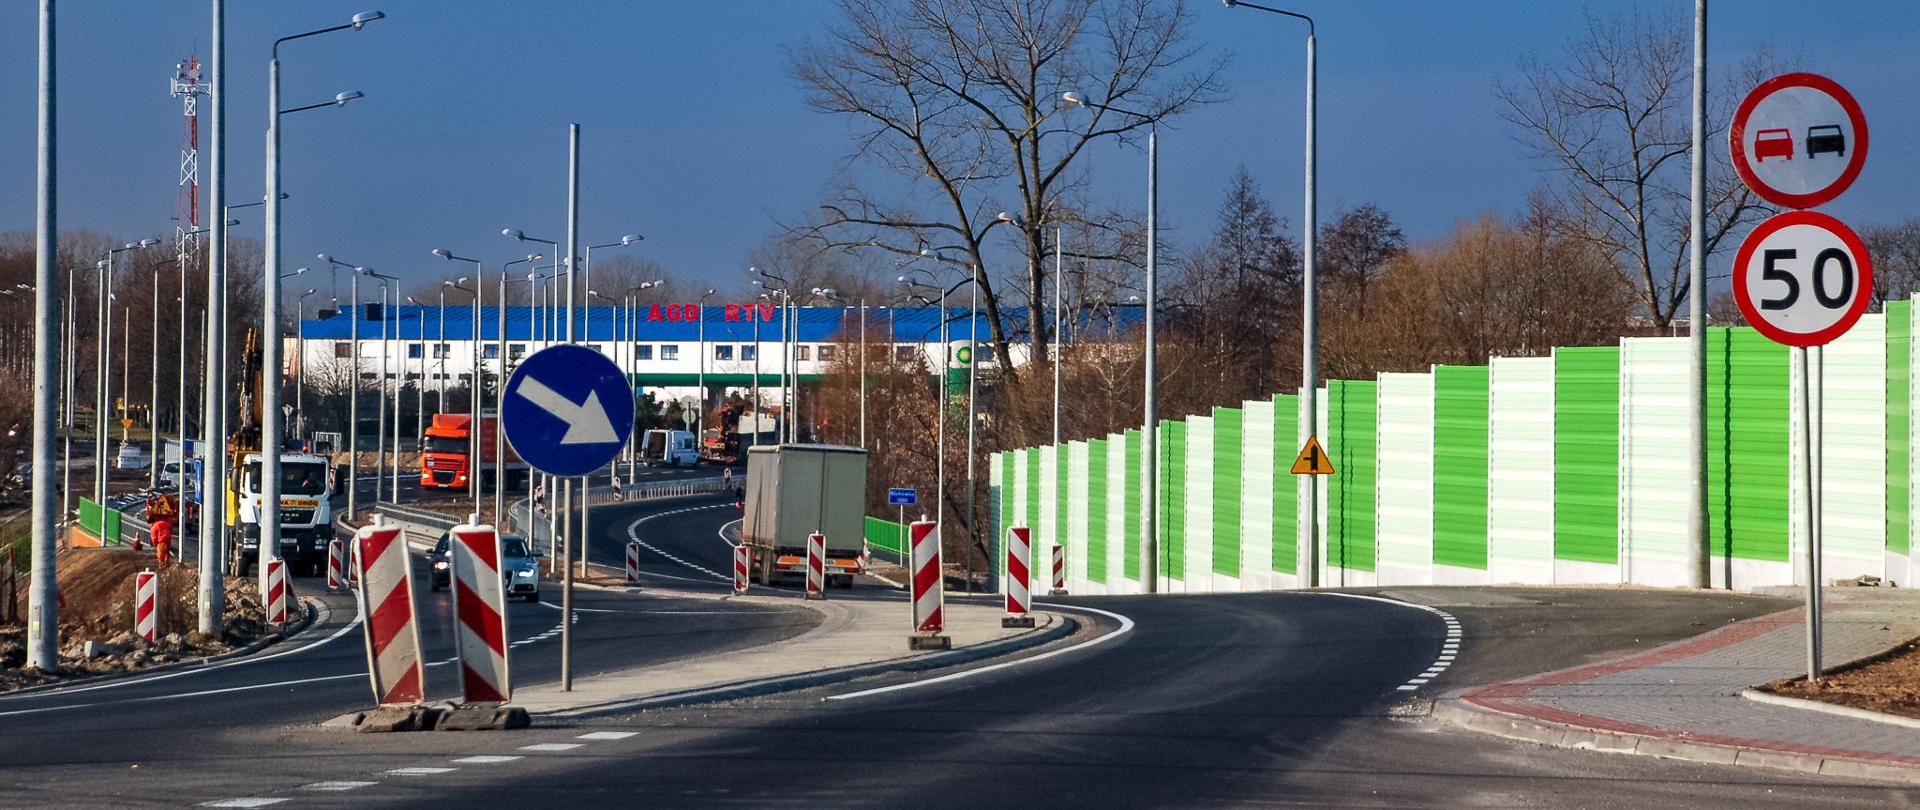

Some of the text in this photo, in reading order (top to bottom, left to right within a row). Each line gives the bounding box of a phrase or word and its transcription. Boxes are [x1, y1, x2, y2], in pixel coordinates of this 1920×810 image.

[1761, 247, 1853, 310] 50
[647, 303, 775, 322] AGD RTV
